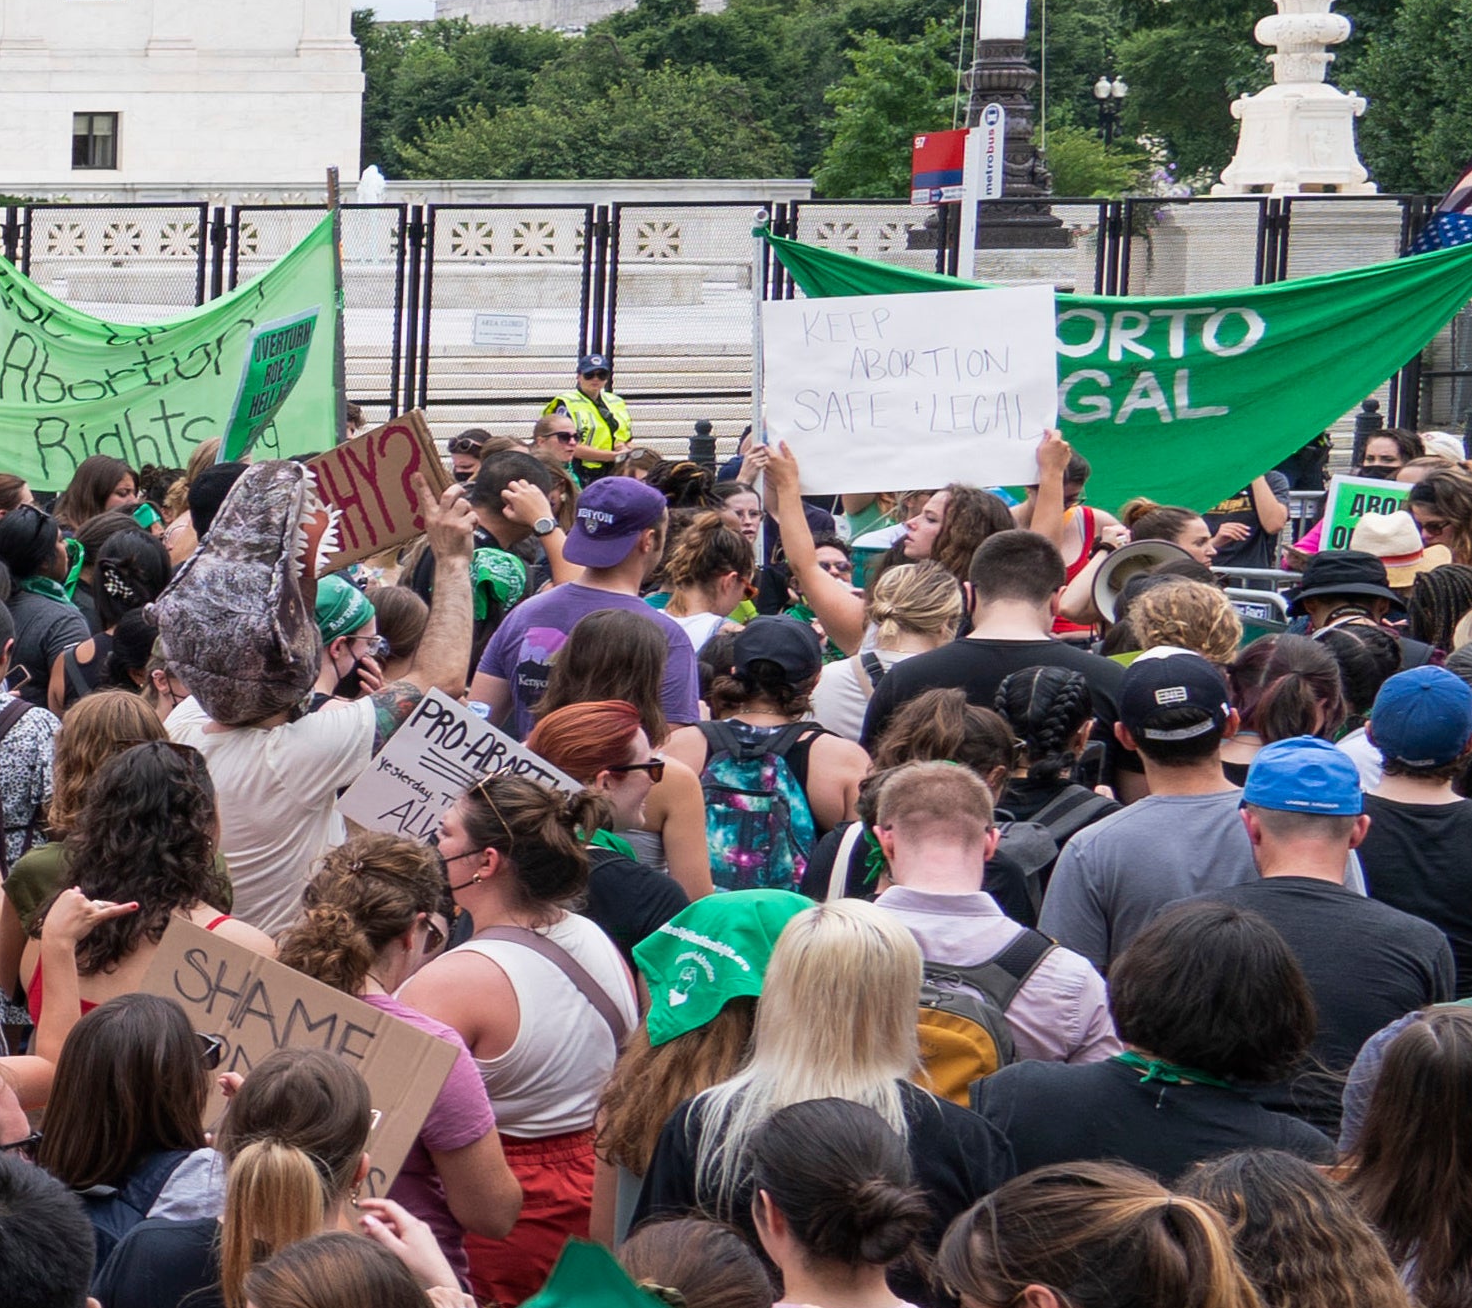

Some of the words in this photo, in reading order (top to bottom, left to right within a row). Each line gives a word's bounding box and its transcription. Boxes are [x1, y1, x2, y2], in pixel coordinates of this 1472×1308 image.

[914, 136, 926, 149] 97
[985, 128, 995, 196] metrobus
[255, 321, 312, 363] OVERTURN
[802, 307, 892, 347] KEEP
[1057, 307, 1267, 362] ORTO
[850, 346, 1011, 382] ABORTION
[793, 389, 892, 433] SAFE
[928, 392, 1045, 441] LEGAL
[1058, 368, 1230, 426] GAL
[517, 673, 549, 690] Kenyo
[174, 948, 376, 1062] SHAME
